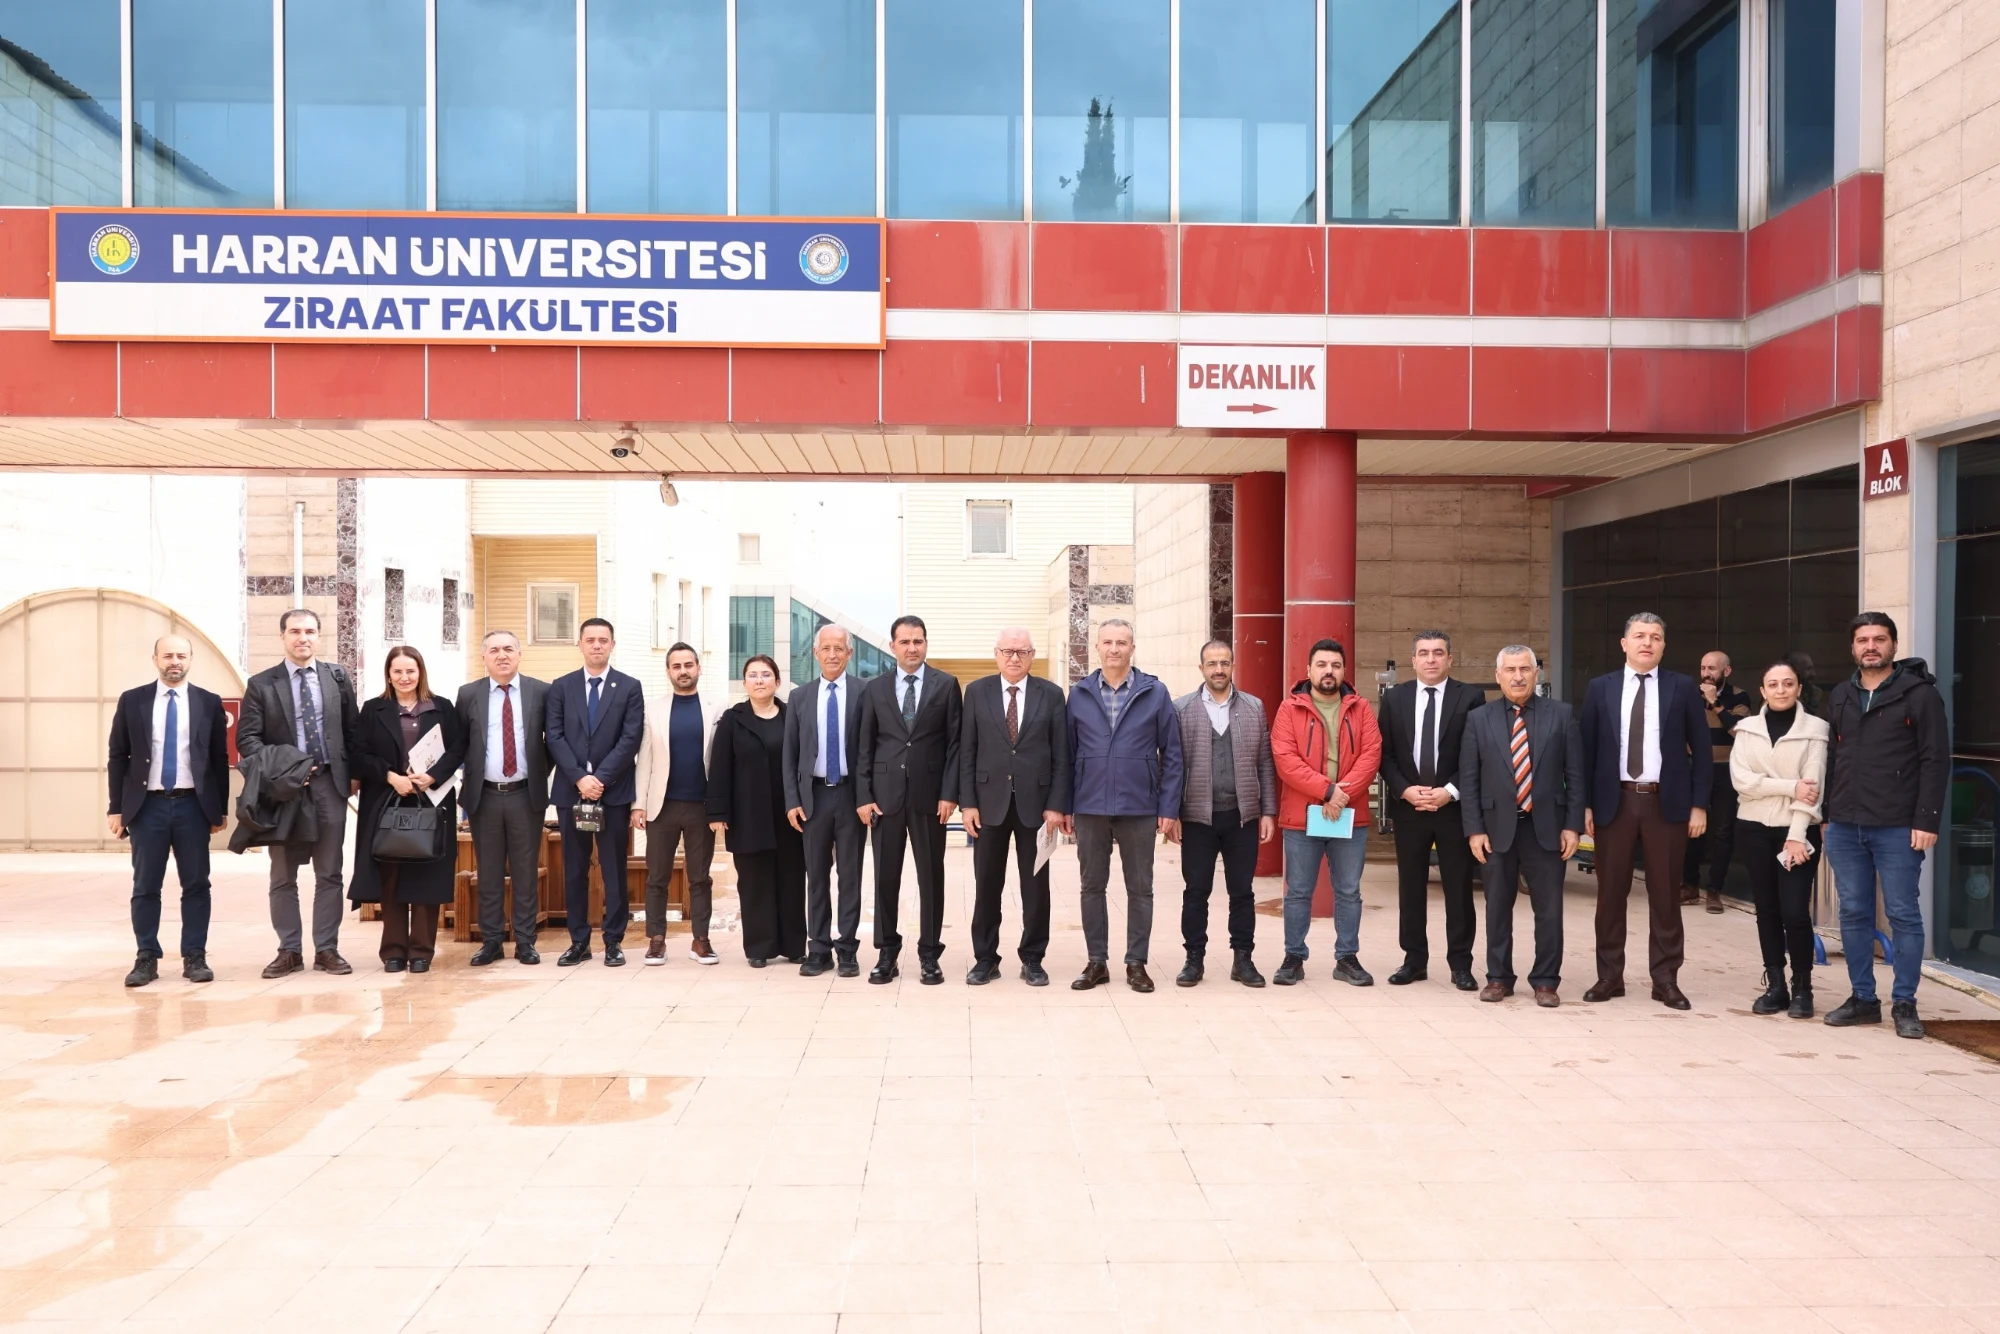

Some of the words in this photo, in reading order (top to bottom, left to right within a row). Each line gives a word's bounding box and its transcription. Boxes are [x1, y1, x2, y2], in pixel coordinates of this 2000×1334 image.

[172, 234, 397, 275] HARRAN
[410, 236, 767, 280] ÜNİVERSİTESİ
[264, 296, 430, 330] ZİRAAT
[441, 298, 677, 333] FAKÜLTESİ
[1188, 363, 1316, 390] DEKANLIK
[1880, 448, 1894, 474] A
[1870, 475, 1902, 495] BLOK
